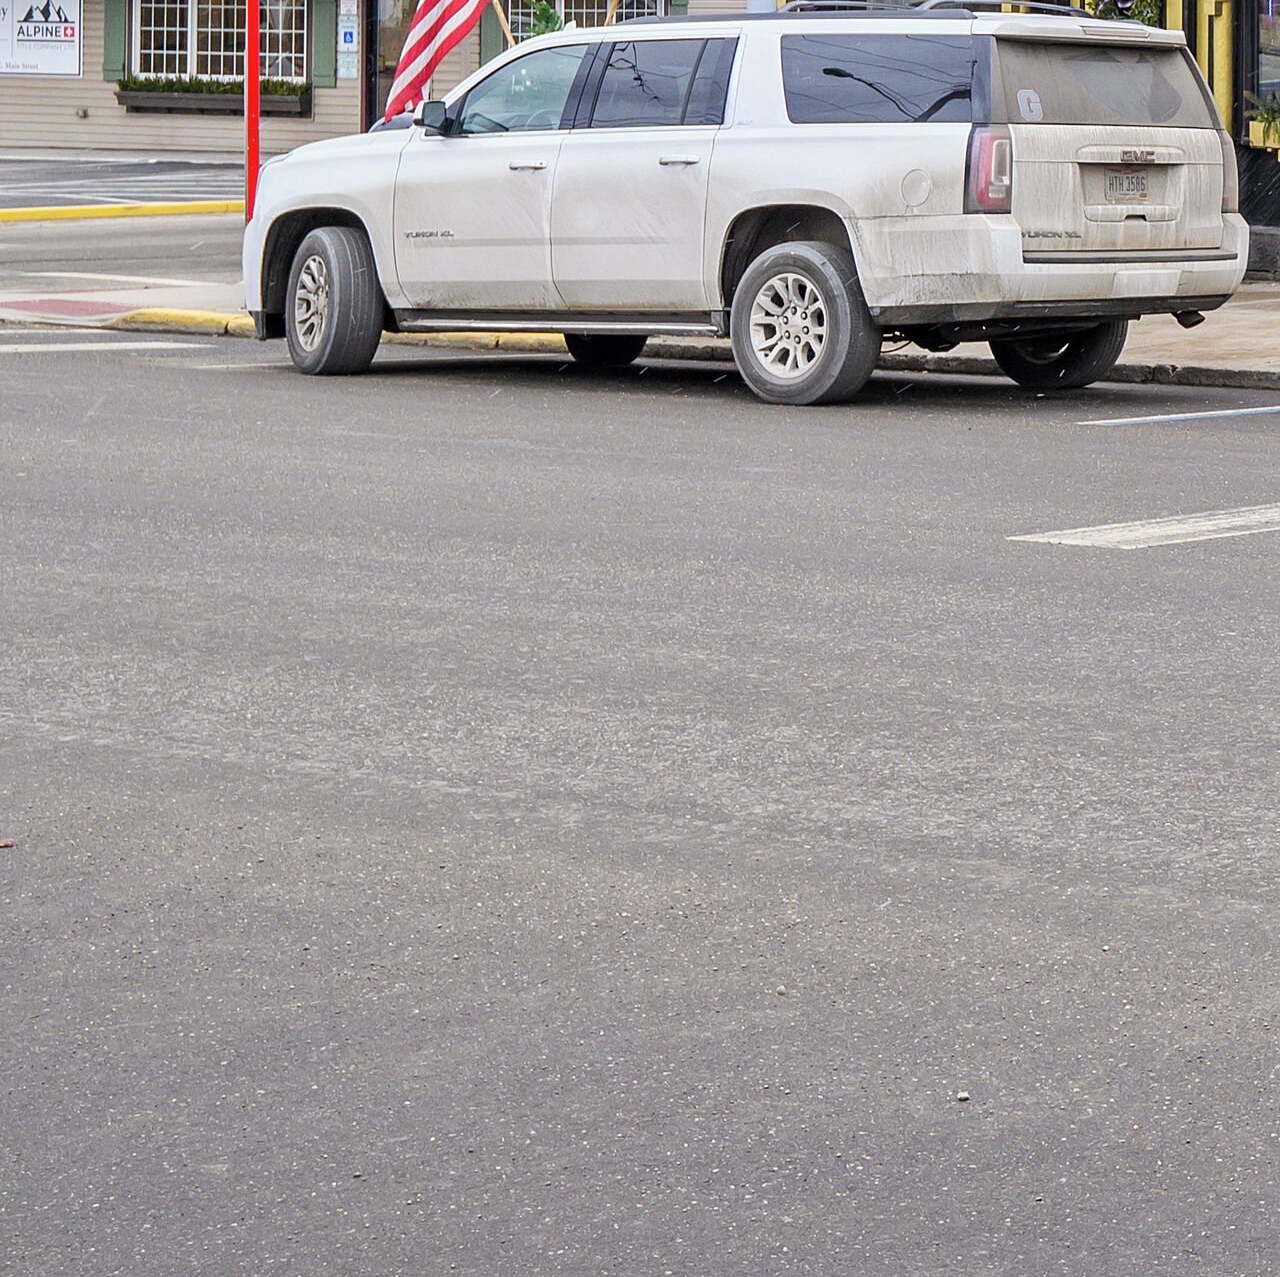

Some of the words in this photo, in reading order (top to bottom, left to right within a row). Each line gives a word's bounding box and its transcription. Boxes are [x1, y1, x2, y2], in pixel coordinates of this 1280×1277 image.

[17, 25, 62, 37] ALPINE
[1017, 89, 1043, 121] G
[1121, 151, 1155, 162] GMC
[1109, 176, 1124, 192] HTH
